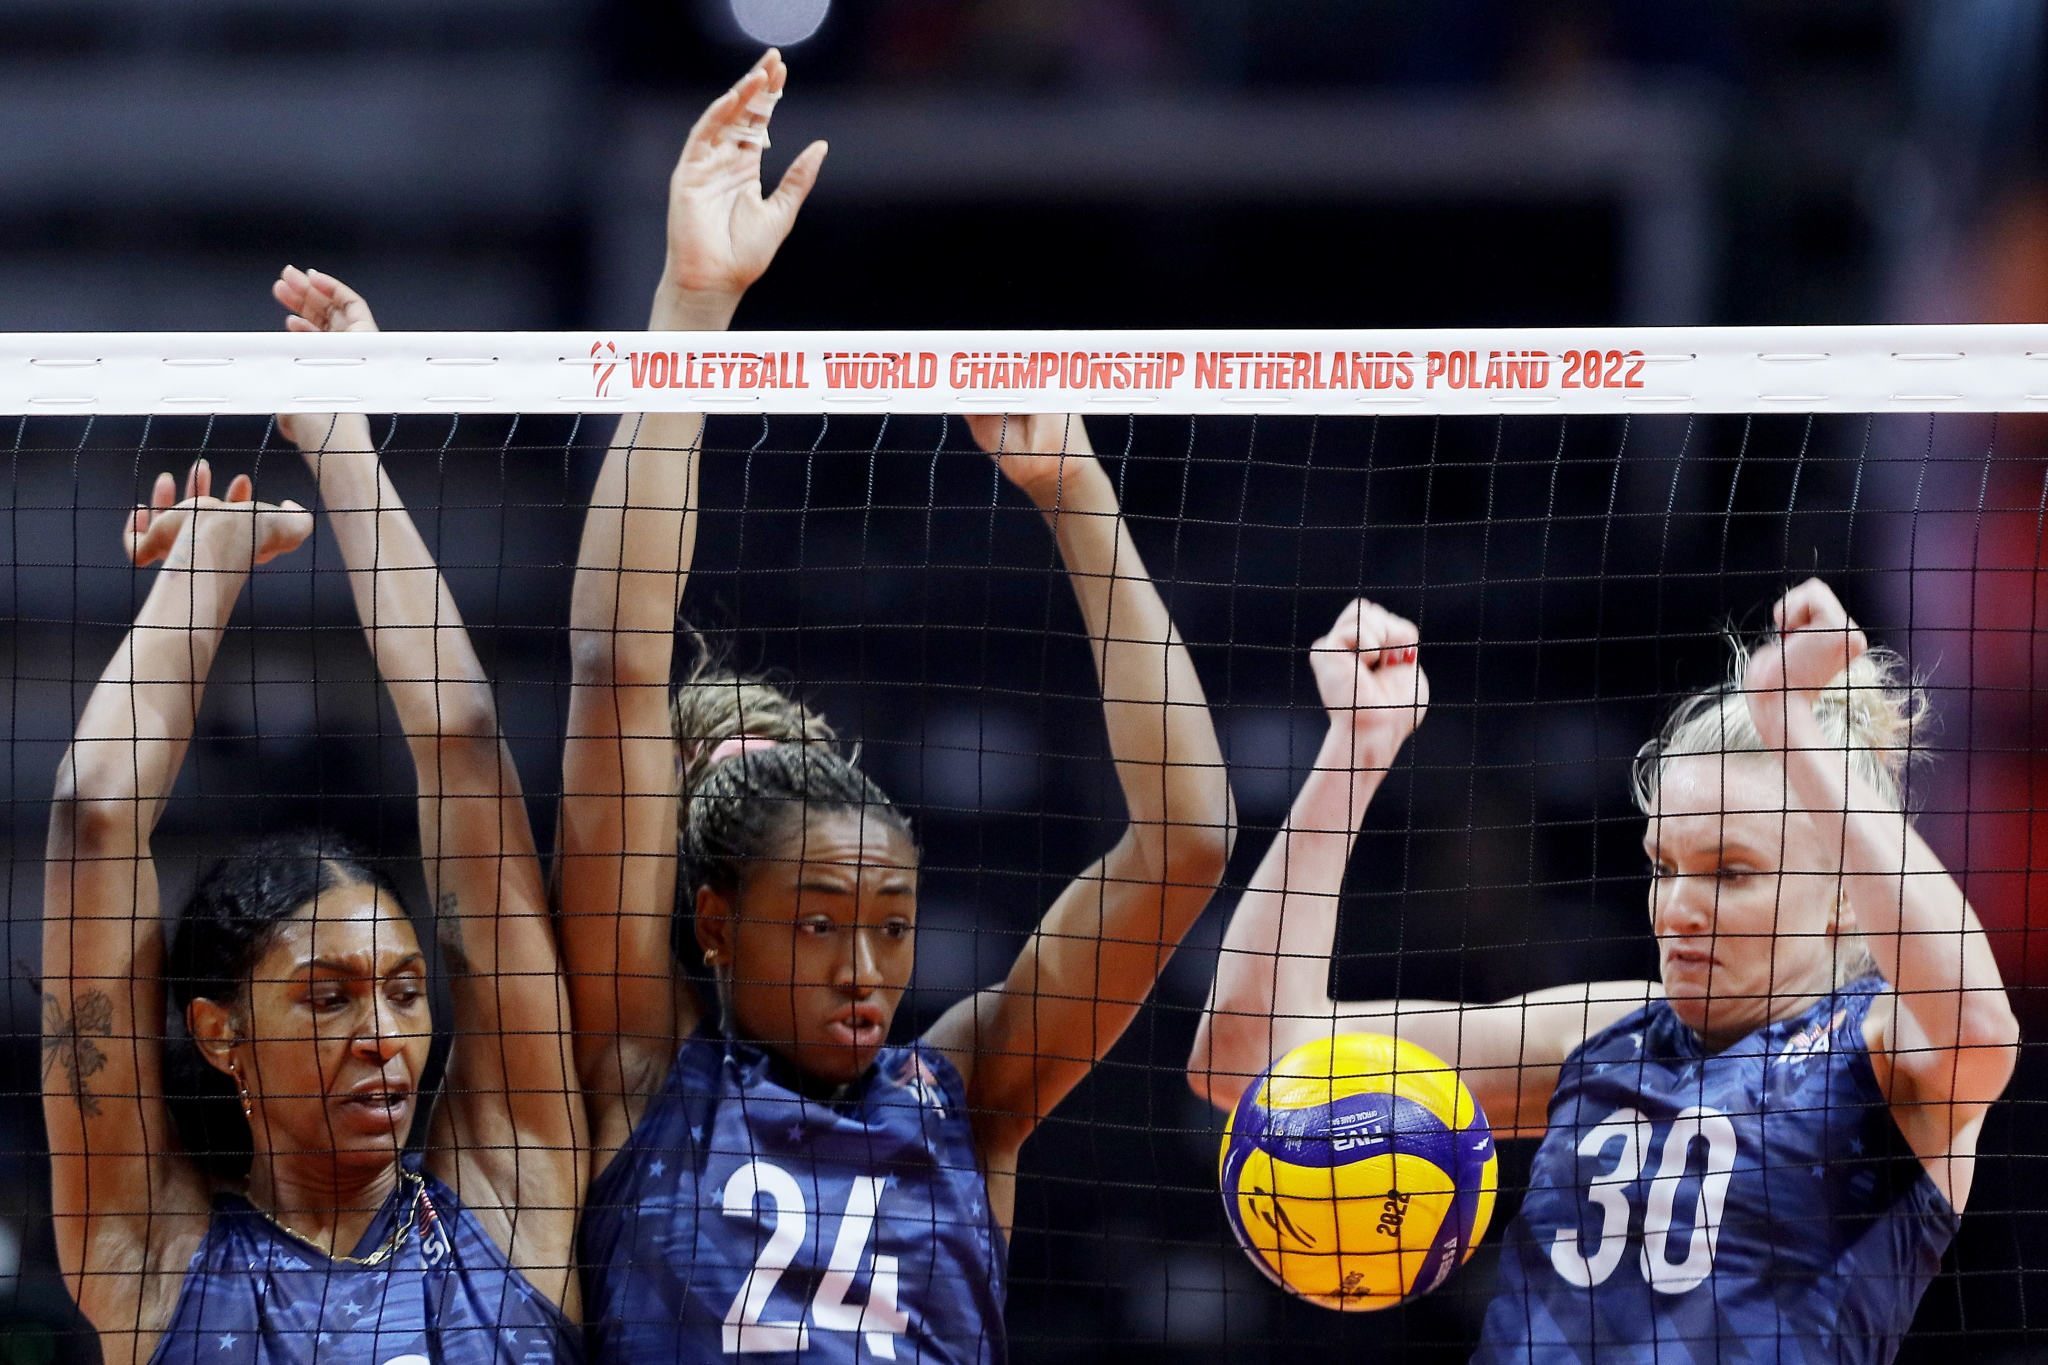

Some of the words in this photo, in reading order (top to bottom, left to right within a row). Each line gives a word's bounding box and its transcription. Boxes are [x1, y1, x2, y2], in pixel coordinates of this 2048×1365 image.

[630, 351, 809, 389] VOLLEYBALL
[823, 351, 938, 389] WORLD
[950, 351, 1185, 389] CHAMPIONSHIP
[1194, 351, 1415, 390] NETHERLANDS
[1426, 350, 1550, 390] POLAND
[1561, 349, 1646, 389] 2022
[722, 1161, 909, 1361] 24
[1551, 1106, 1738, 1295] 30
